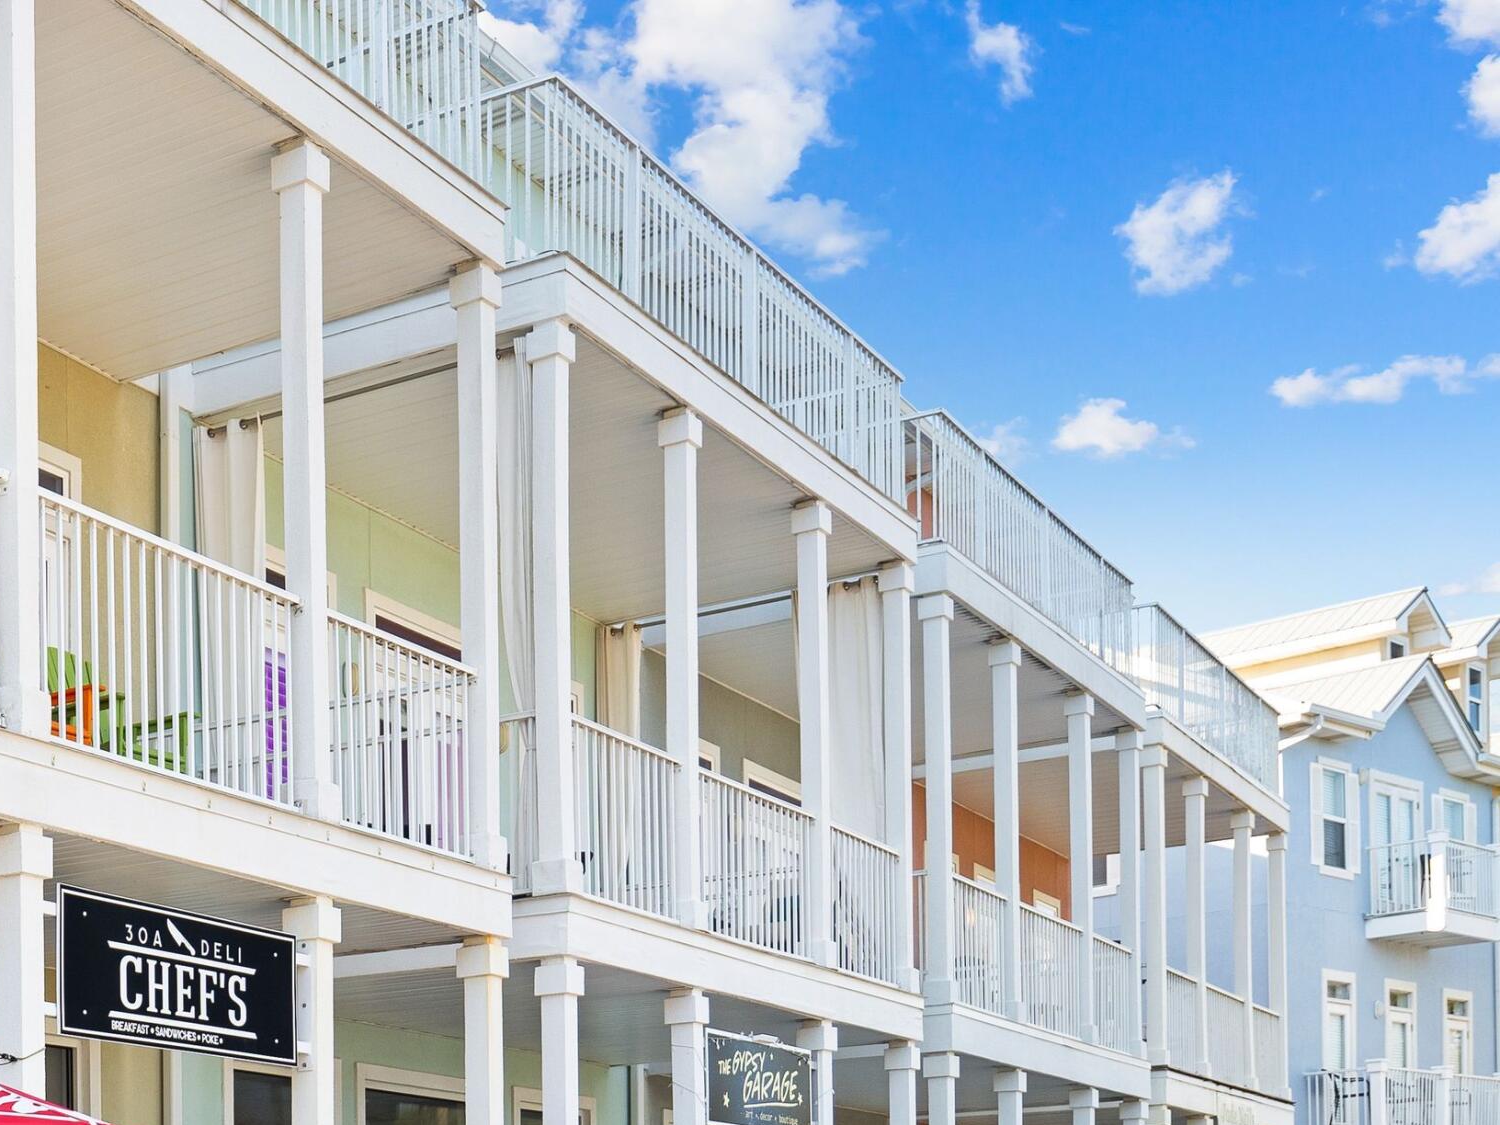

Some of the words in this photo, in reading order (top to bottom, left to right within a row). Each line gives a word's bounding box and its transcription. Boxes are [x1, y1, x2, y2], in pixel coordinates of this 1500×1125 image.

[200, 939, 242, 964] DELI
[119, 955, 248, 1027] CHEF'S
[111, 1020, 149, 1035] BREAKFAST
[155, 1026, 197, 1041] SANDWICHES
[201, 1033, 220, 1045] POKE
[718, 1058, 732, 1075] THE
[731, 1050, 766, 1075] GYPSY
[743, 1070, 799, 1103] GARAGE
